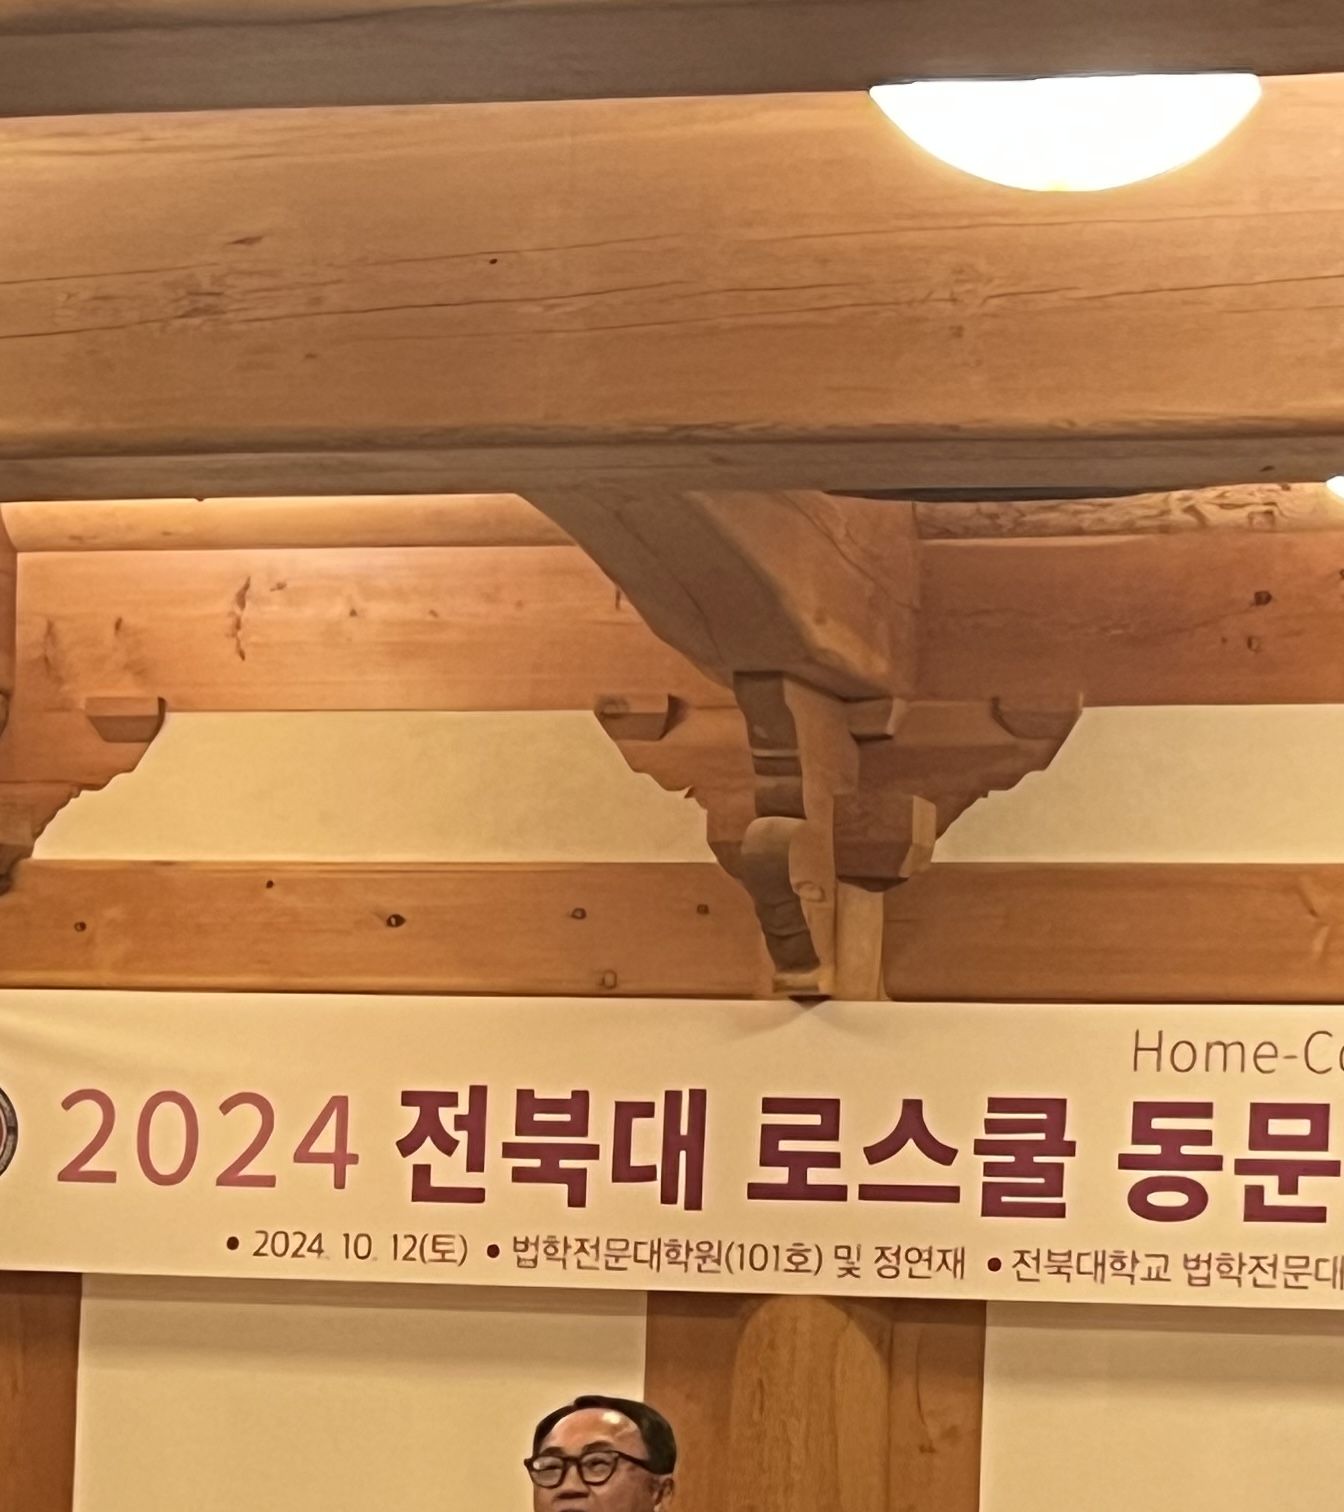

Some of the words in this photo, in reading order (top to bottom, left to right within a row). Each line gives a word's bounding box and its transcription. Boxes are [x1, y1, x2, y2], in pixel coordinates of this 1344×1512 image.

[56, 1087, 360, 1191] 2024
[394, 1084, 706, 1211] 전북대
[746, 1095, 1077, 1219] 로스쿨
[392, 1232, 469, 1266] 12(토)
[512, 1233, 823, 1277] 법학전문대학원(101호)
[833, 1242, 863, 1280] 및
[873, 1244, 966, 1281] 정연재
[1012, 1249, 1172, 1285] 전북대학교
